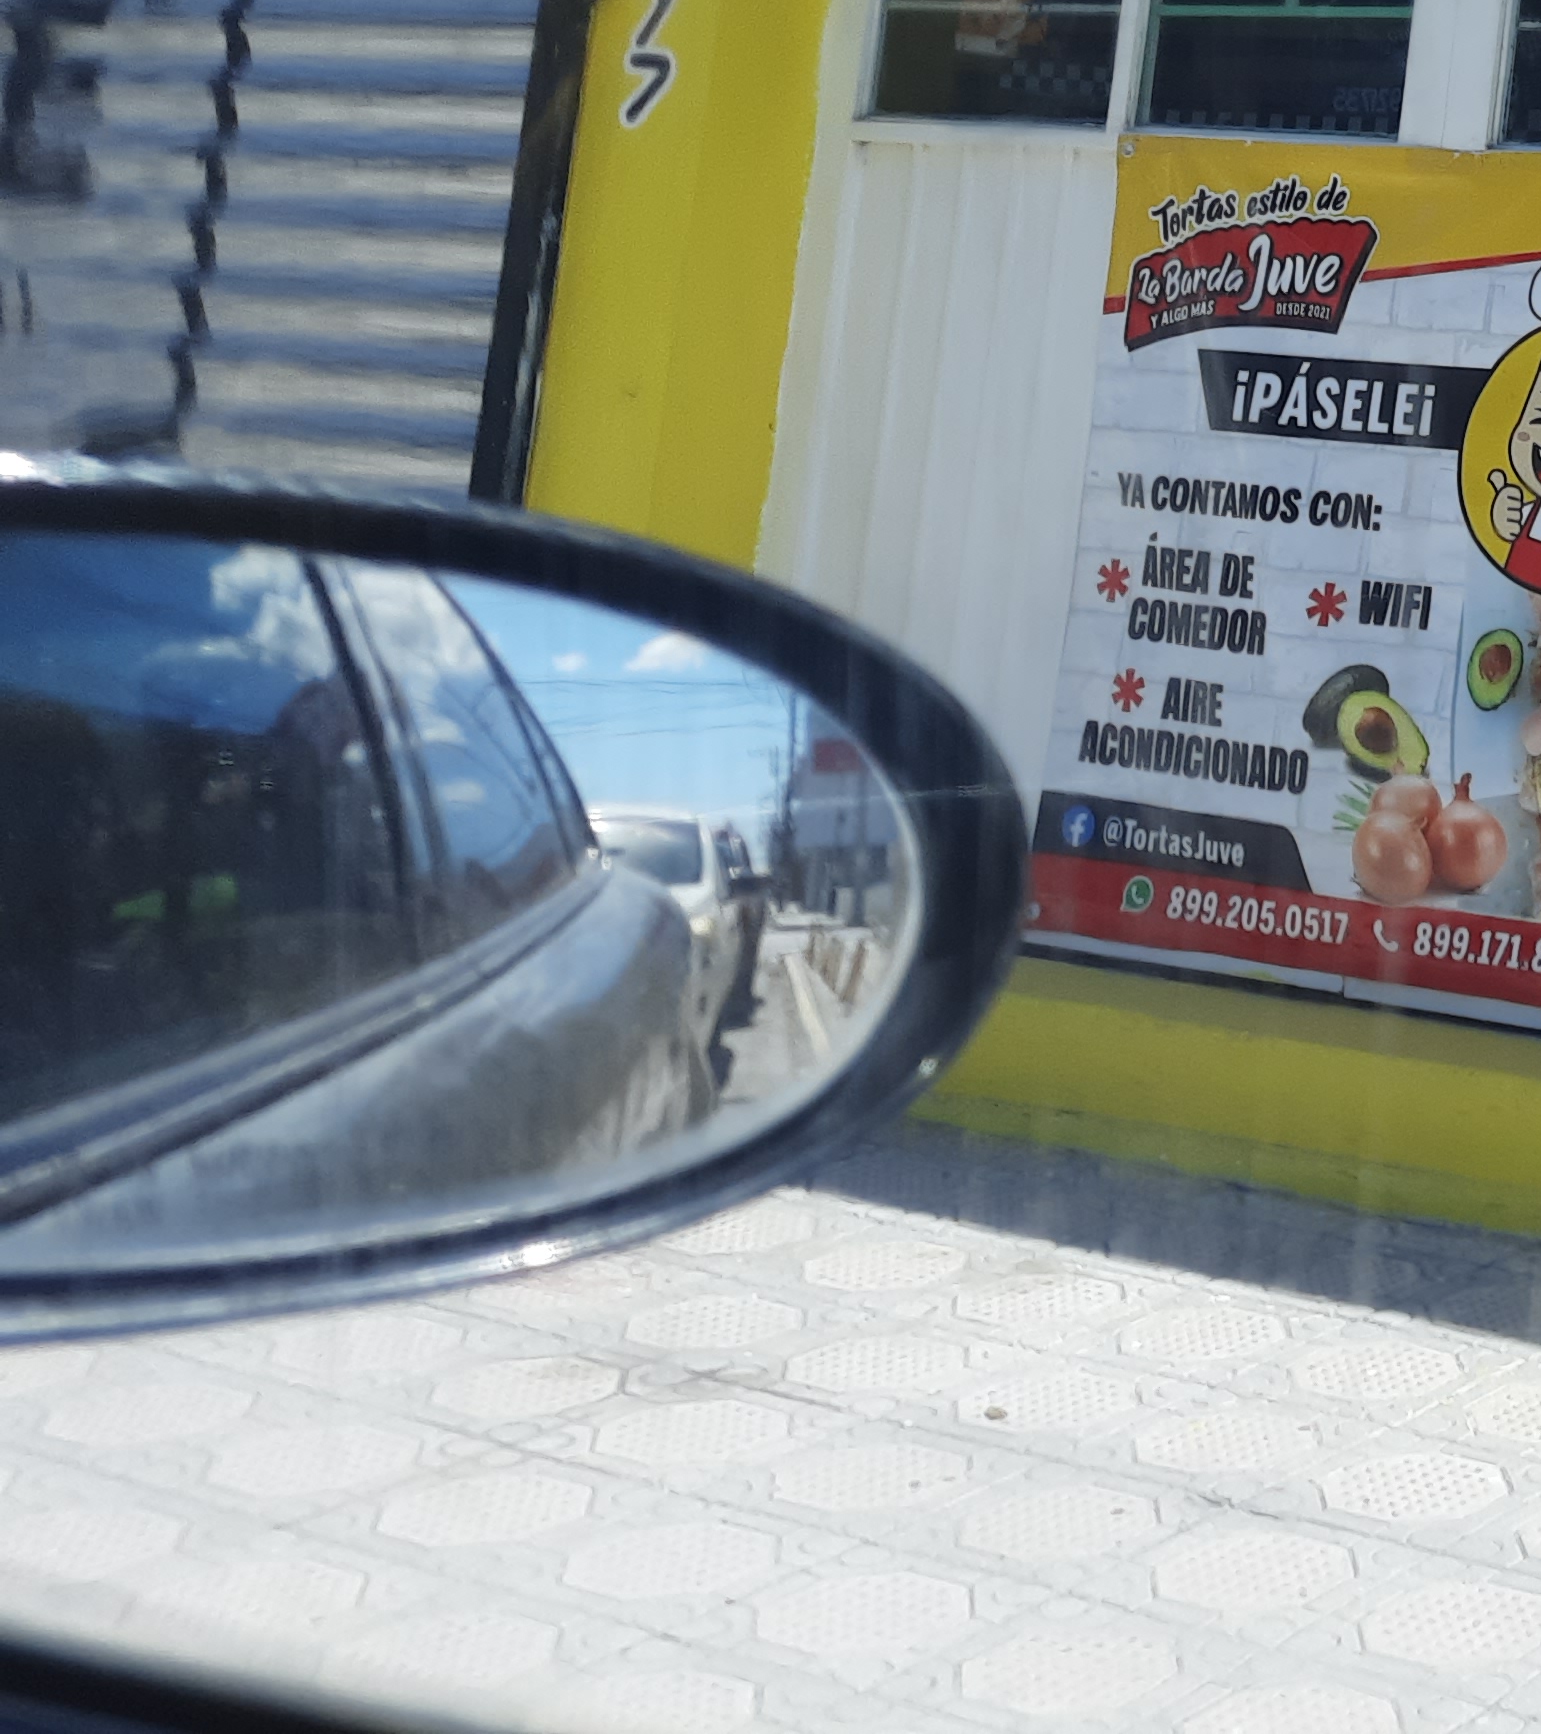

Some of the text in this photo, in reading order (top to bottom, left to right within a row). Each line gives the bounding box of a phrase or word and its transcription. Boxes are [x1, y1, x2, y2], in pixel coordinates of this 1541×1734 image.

[1151, 176, 1348, 242] Tortas estilo de
[1138, 233, 1343, 312] La Barda Juve
[1151, 295, 1215, 330] Y ALGO MÁS
[1276, 302, 1331, 321] DESDE 2021
[1117, 472, 1382, 532] YA CONTAMOS CON:
[1141, 531, 1255, 599] ÁREA DE
[1127, 599, 1267, 656] COMEDOR
[1358, 580, 1434, 631] WIFI
[1160, 676, 1224, 727] AIRE
[1078, 720, 1310, 795] ACONDICIONADO
[1102, 816, 1246, 868] @TortasJuve
[1165, 885, 1350, 945] 899.205.0517
